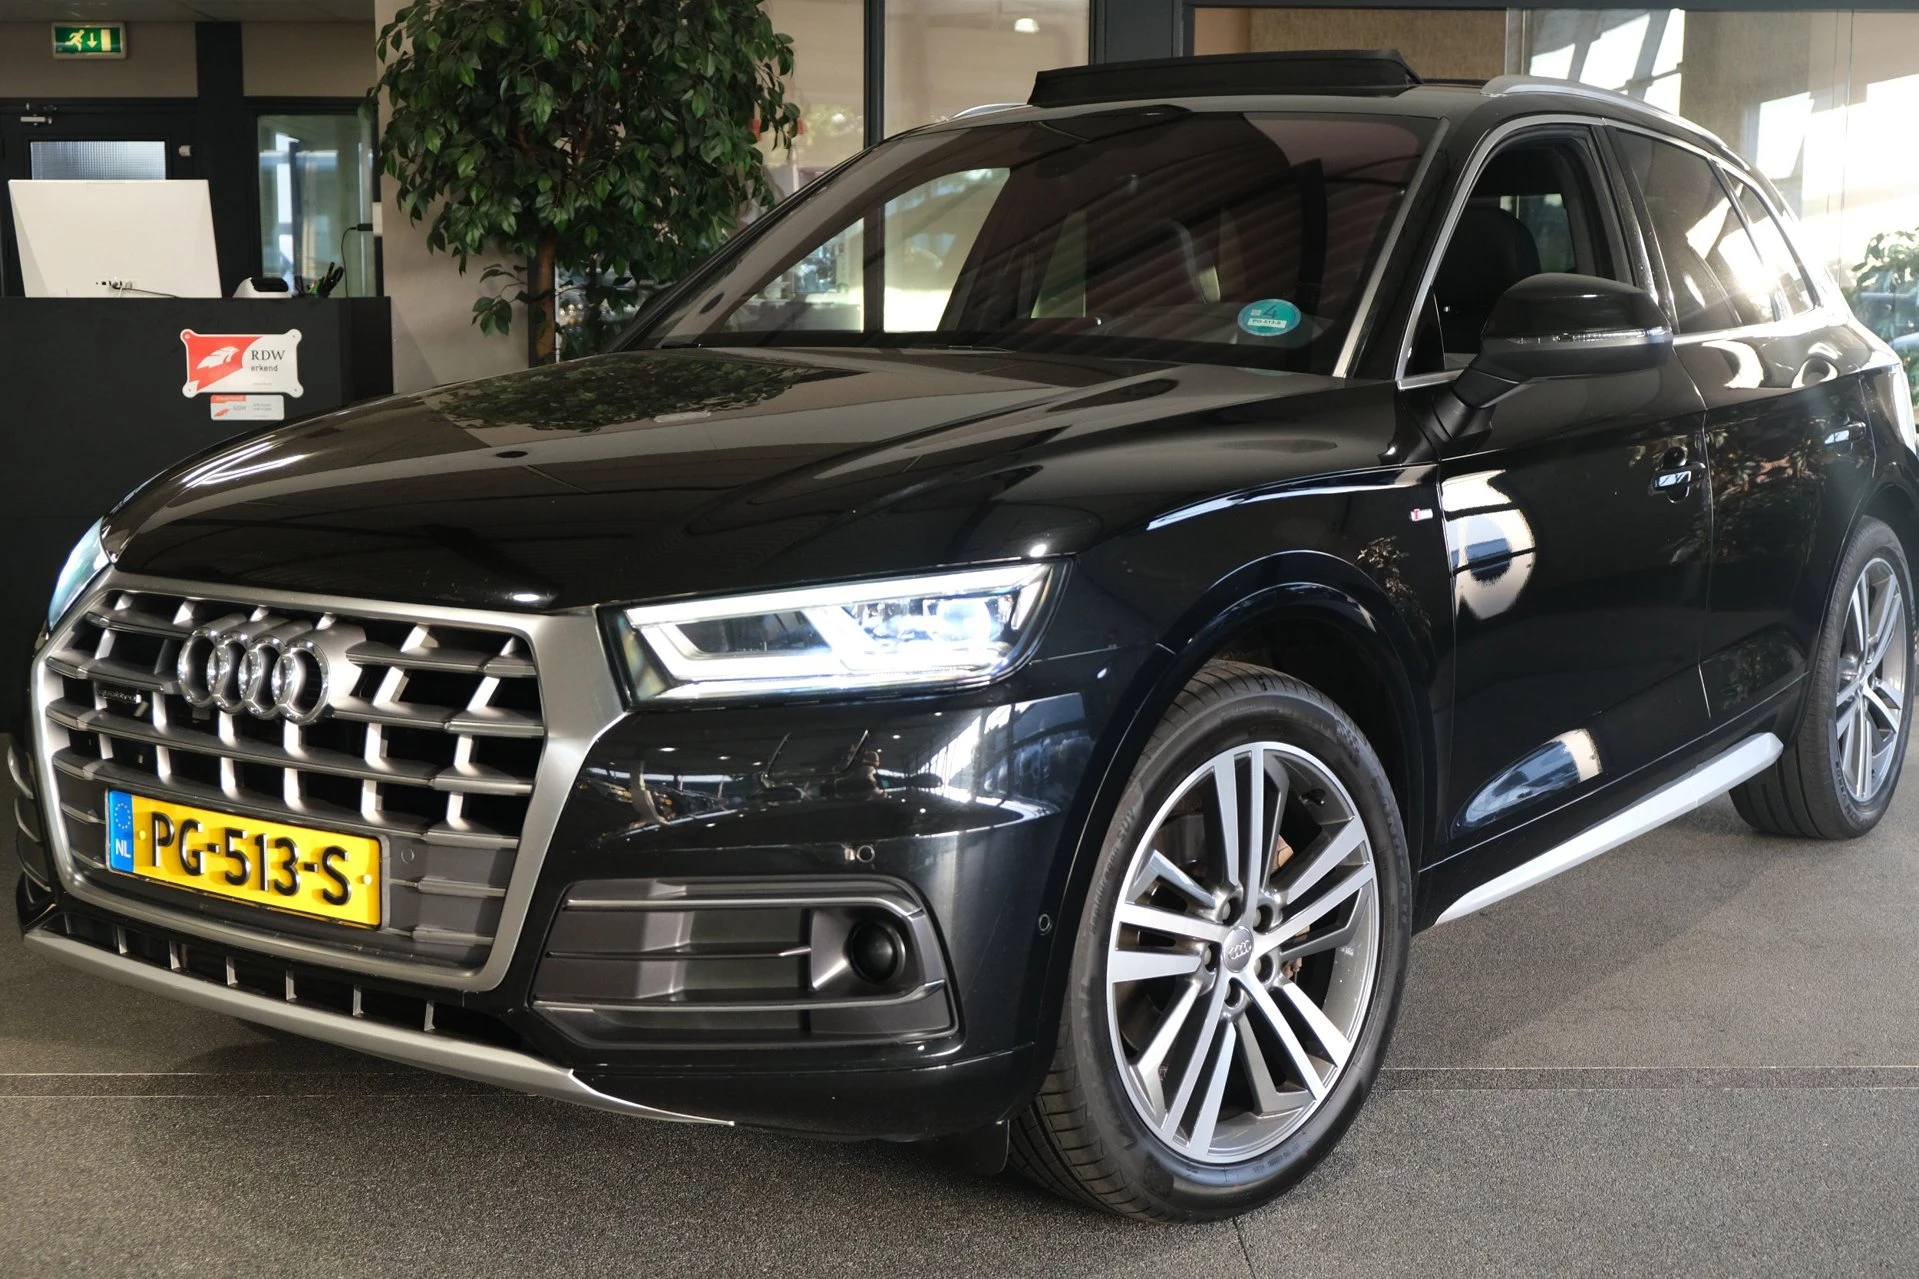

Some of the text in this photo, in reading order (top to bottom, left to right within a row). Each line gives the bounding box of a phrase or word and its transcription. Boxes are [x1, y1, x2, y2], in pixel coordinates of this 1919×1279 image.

[1262, 304, 1278, 318] 4
[250, 349, 286, 361] RDW
[250, 364, 279, 372] erkend
[114, 838, 132, 859] NL
[151, 811, 352, 906] PG-513-S
